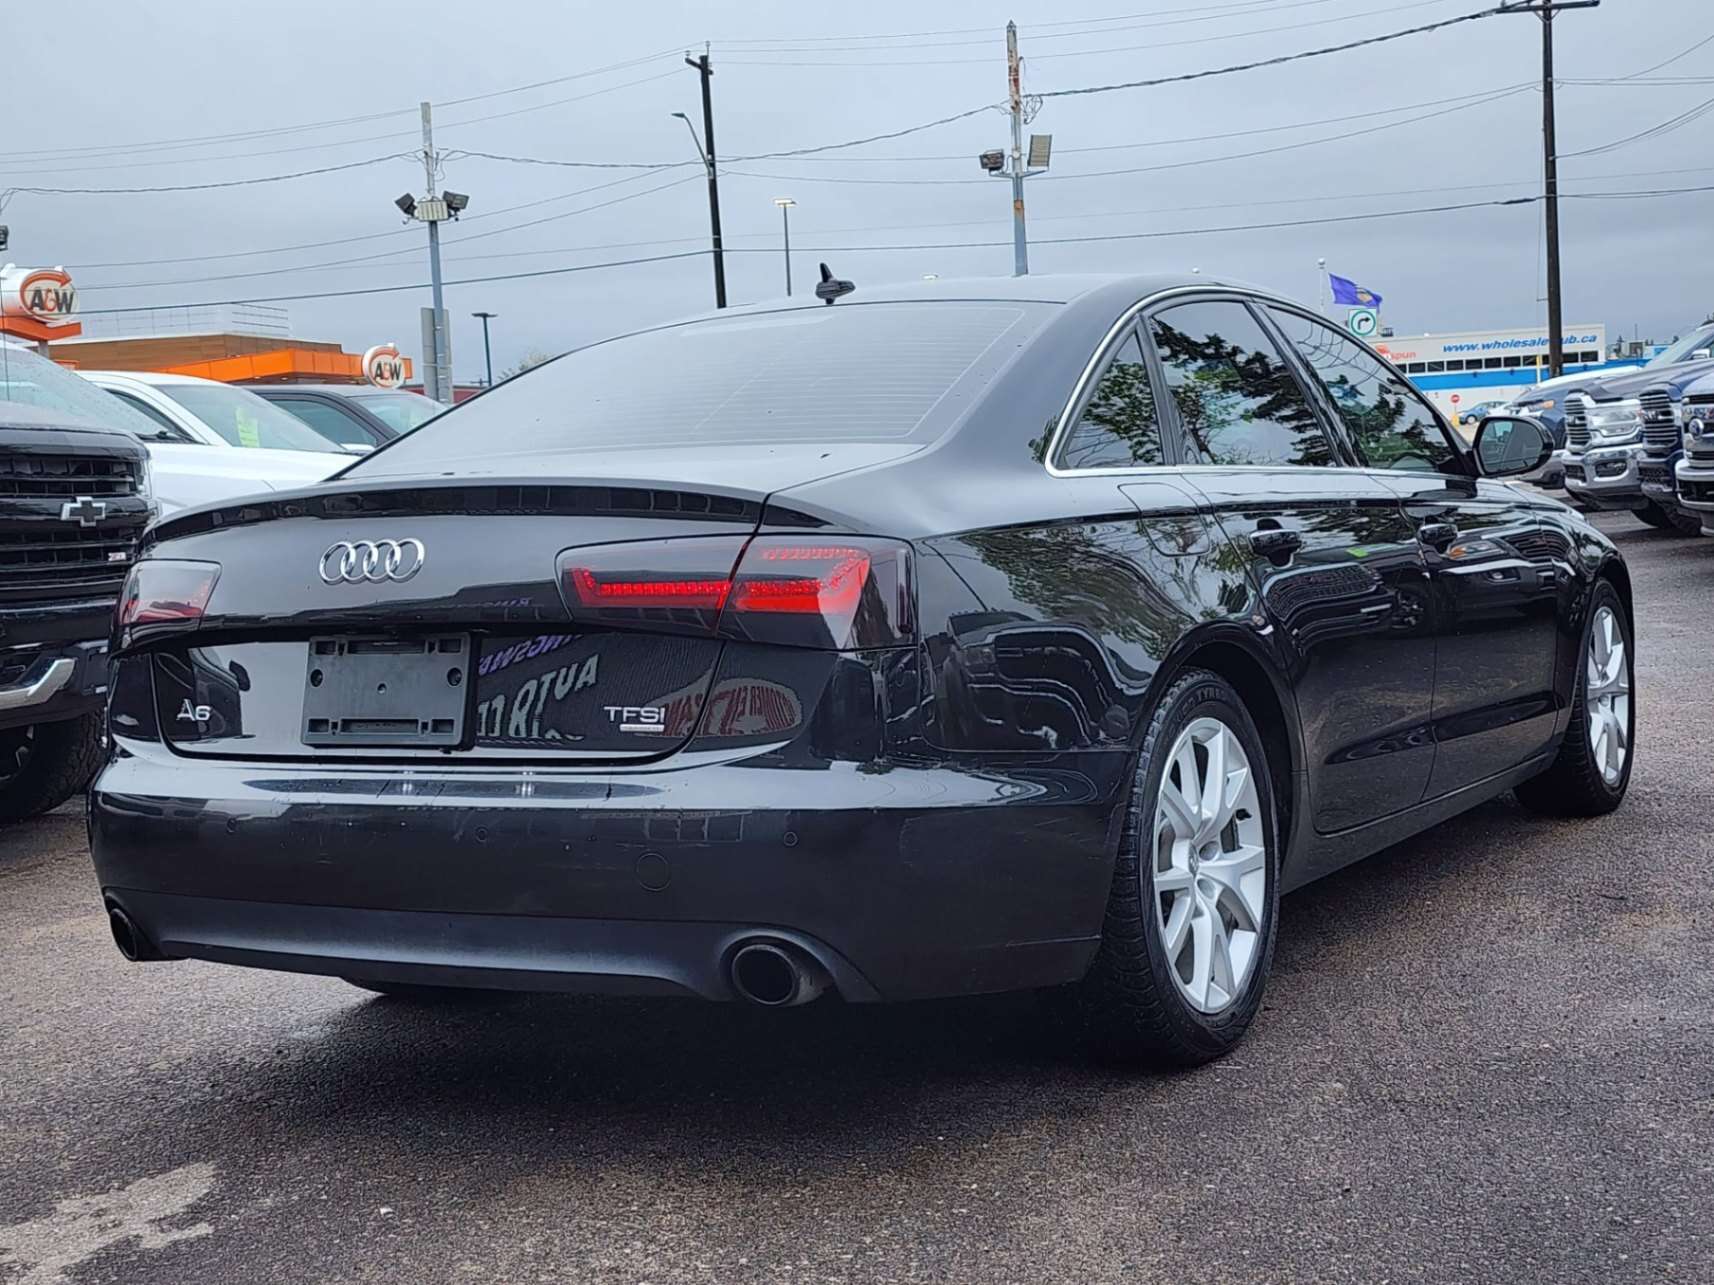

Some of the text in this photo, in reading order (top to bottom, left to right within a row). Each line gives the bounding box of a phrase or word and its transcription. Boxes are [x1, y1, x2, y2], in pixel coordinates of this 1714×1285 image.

[30, 287, 75, 314] A&W
[1443, 335, 1597, 352] www.wholesaleub.ca
[176, 699, 211, 721] A6
[603, 706, 666, 723] TFSI
